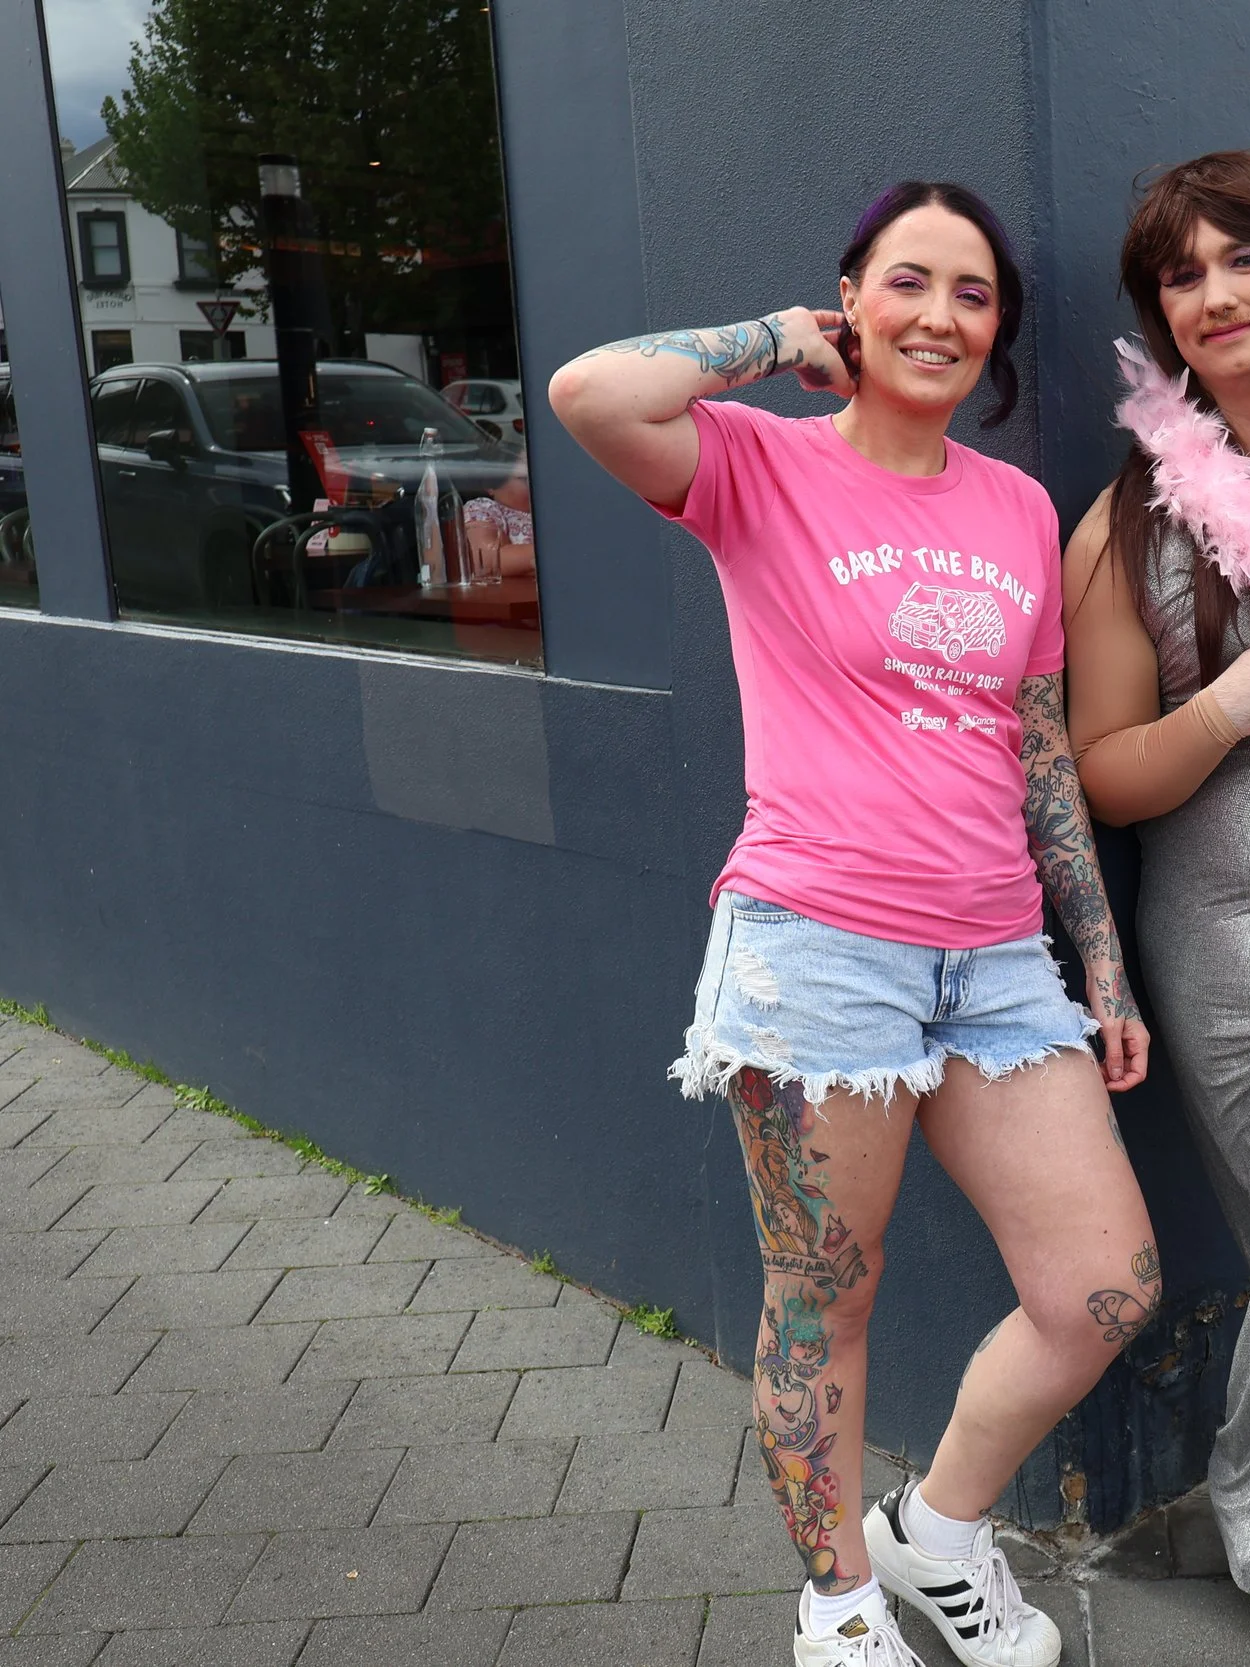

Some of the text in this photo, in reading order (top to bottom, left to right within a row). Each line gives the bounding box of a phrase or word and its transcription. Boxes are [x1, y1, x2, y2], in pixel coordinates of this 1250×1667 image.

[911, 547, 964, 576] THE
[970, 555, 1037, 616] BRAVE
[935, 667, 975, 686] RALLY
[976, 673, 1005, 691] 2025
[972, 715, 996, 725] Cancer
